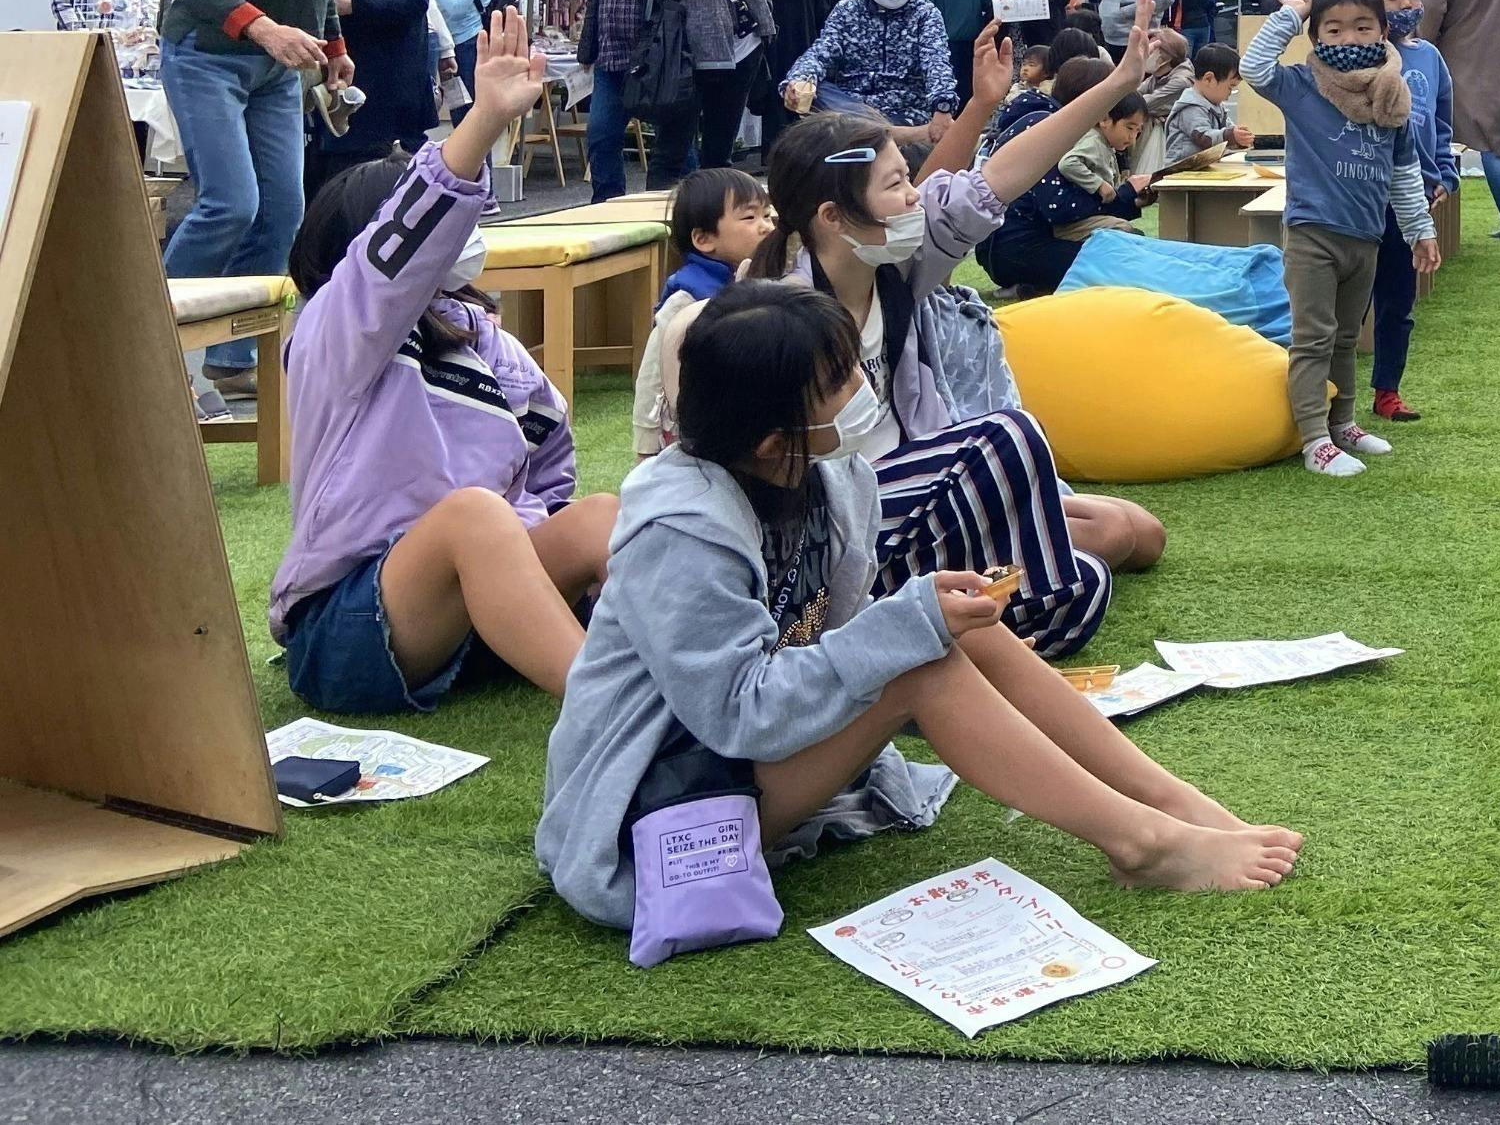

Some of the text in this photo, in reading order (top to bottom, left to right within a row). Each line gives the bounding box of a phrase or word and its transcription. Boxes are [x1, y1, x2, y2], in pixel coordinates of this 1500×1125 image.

[771, 587, 792, 622] LOVE
[666, 824, 739, 845] LTXC GIRL
[667, 833, 739, 855] SEIZE THE DAY
[669, 871, 692, 881] GO-TO
[686, 862, 700, 870] THIS
[907, 870, 991, 907] お散歩市
[986, 878, 1075, 939] スタンプラリー
